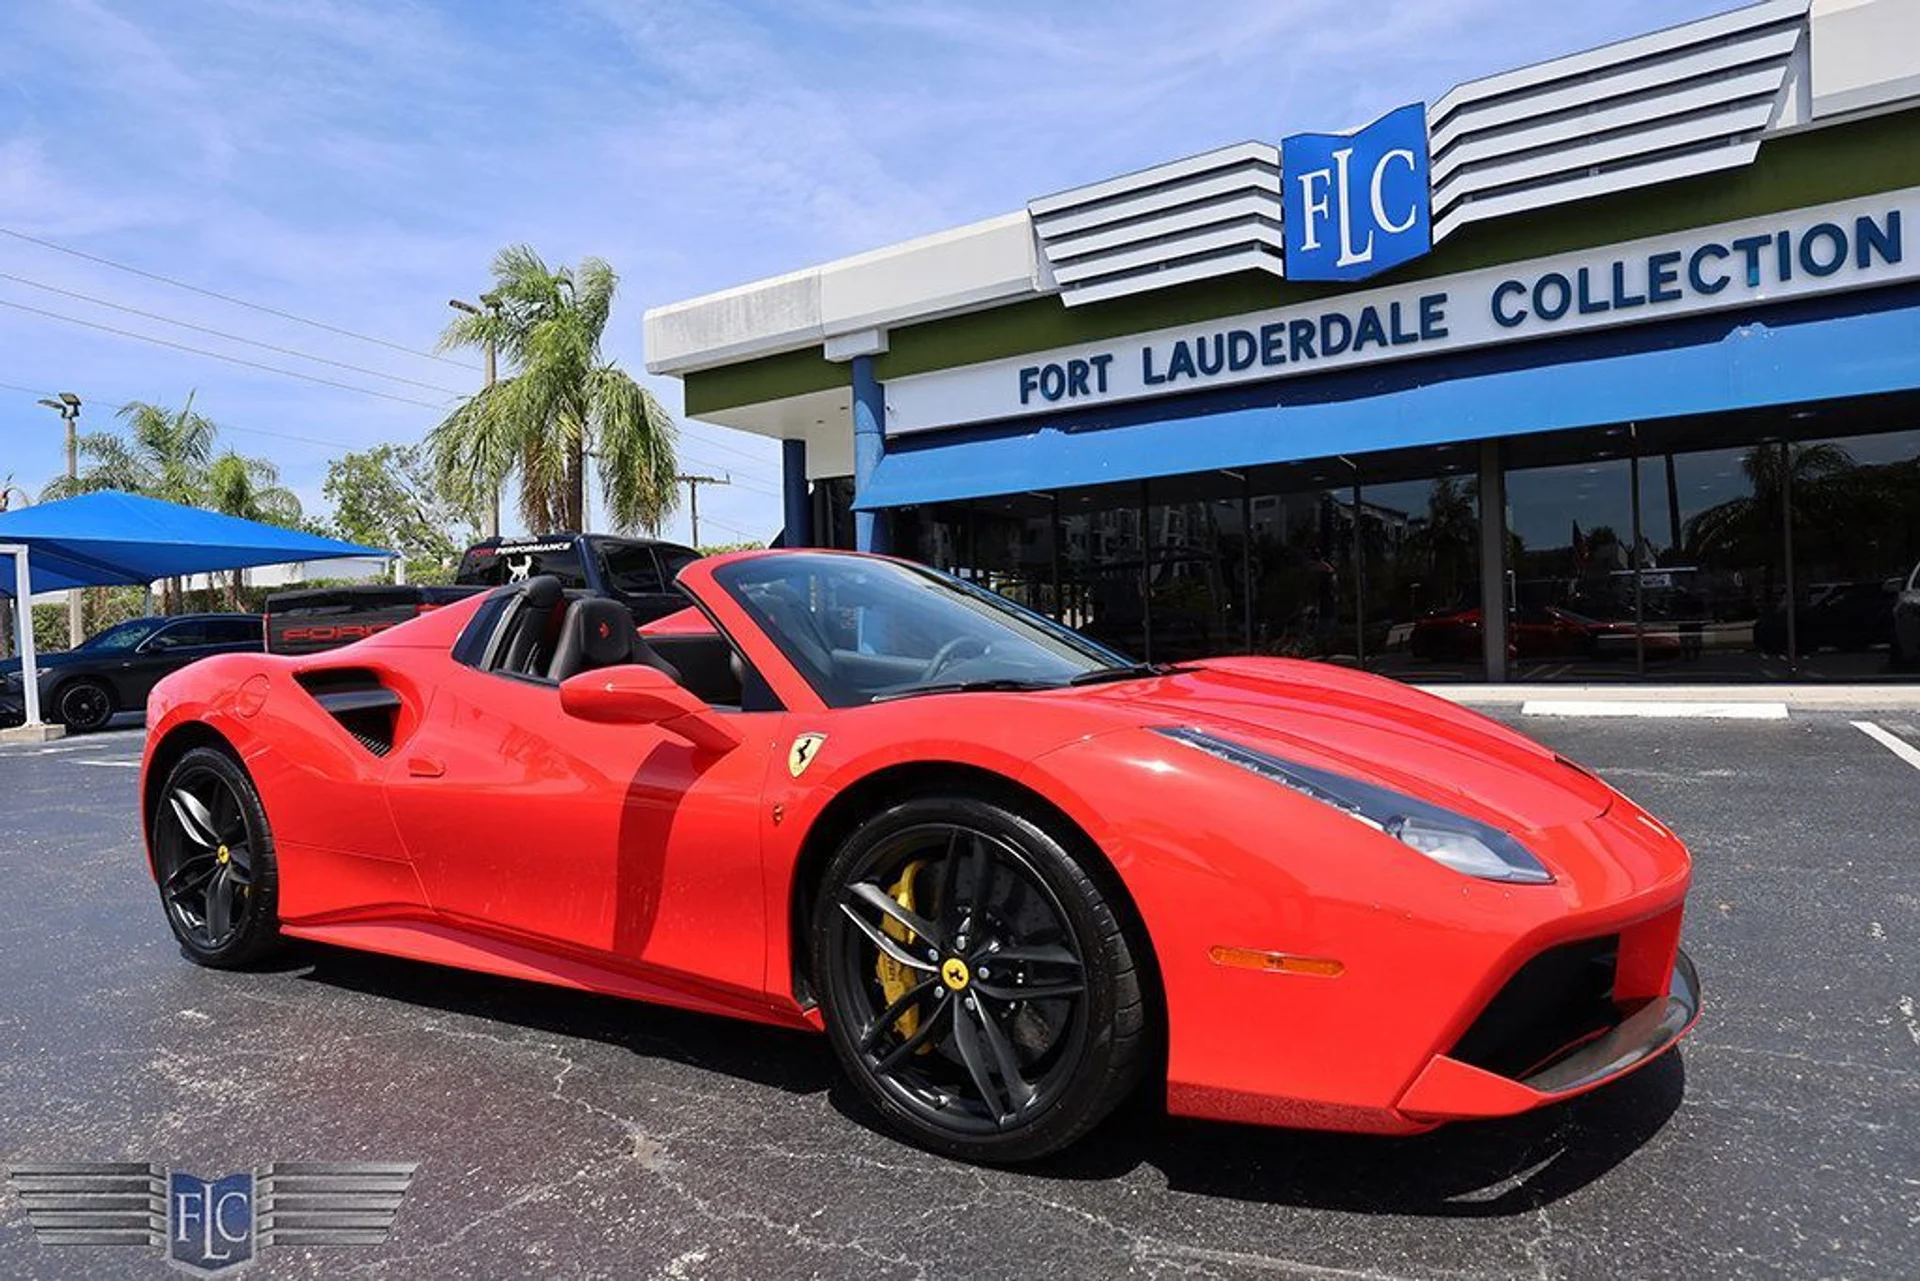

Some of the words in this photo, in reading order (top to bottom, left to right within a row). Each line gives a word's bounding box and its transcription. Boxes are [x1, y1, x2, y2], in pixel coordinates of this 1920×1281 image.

[1298, 148, 1417, 267] FLC
[1020, 354, 1112, 403] FORT
[1143, 293, 1449, 385] LAUDERDALE
[1491, 210, 1902, 328] COLLECTION
[494, 542, 571, 555] PERFORMANCE
